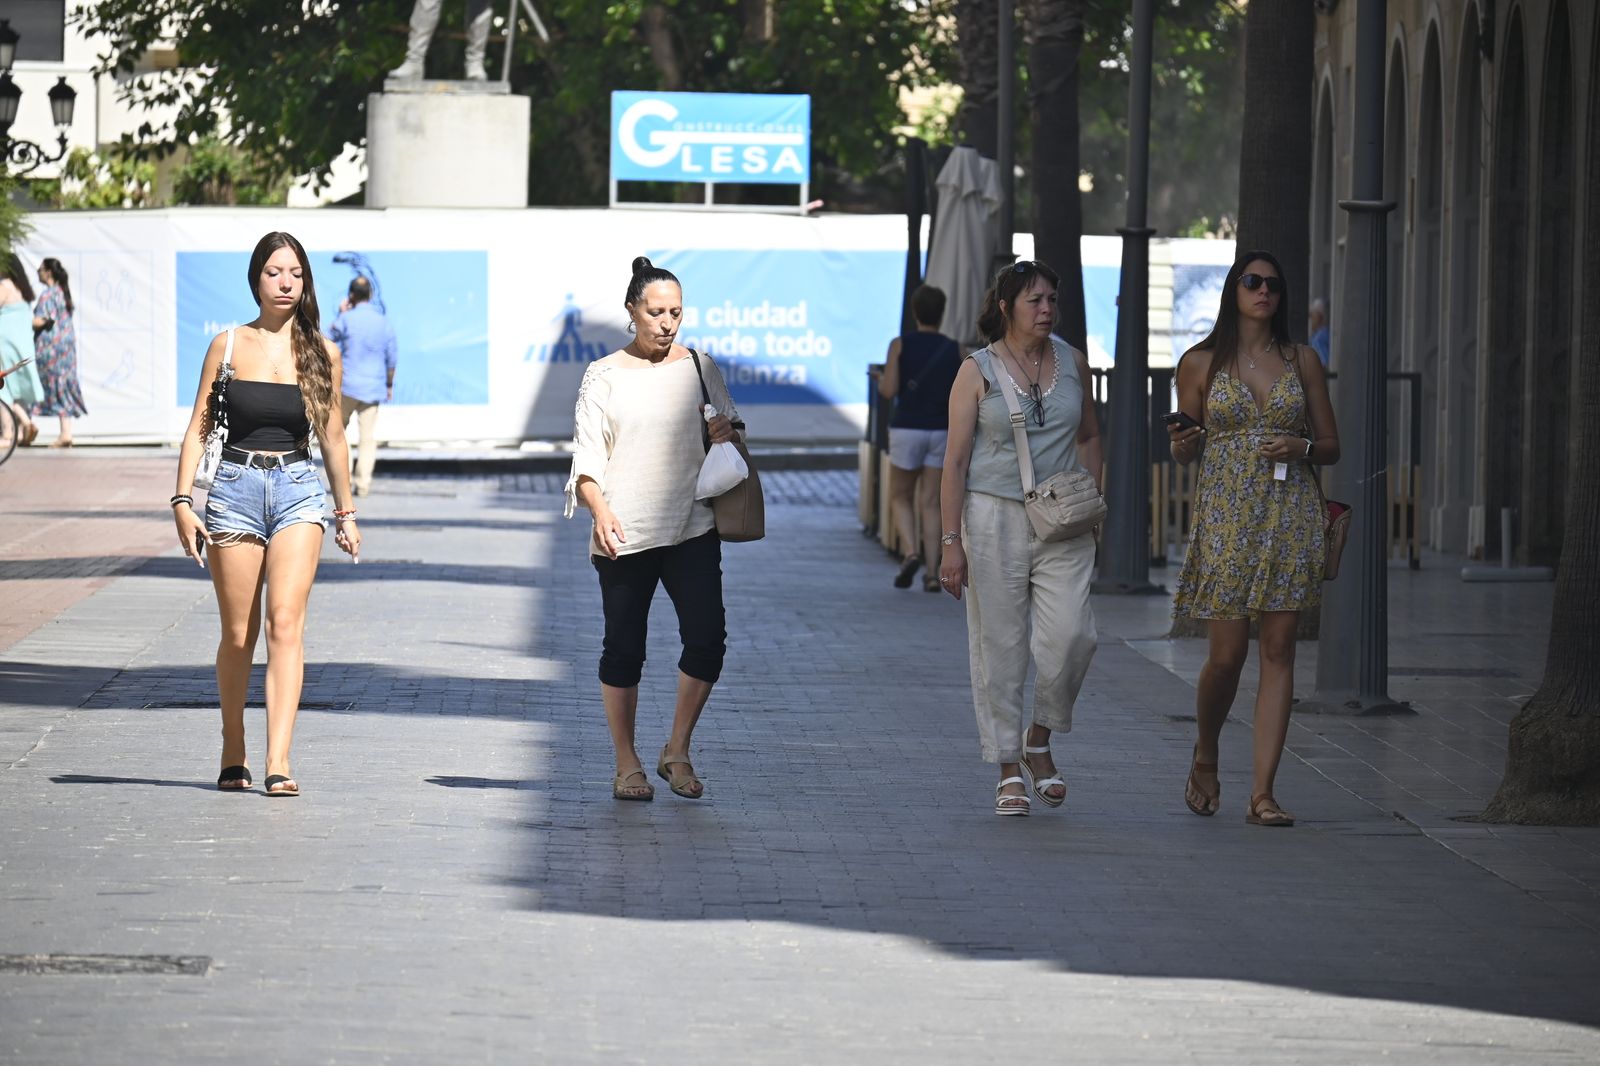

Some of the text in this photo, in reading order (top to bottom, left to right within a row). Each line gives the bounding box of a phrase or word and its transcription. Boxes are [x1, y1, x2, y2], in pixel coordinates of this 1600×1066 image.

[705, 300, 807, 328] ciudad
[765, 328, 832, 357] todo
[721, 358, 807, 385] ienza
